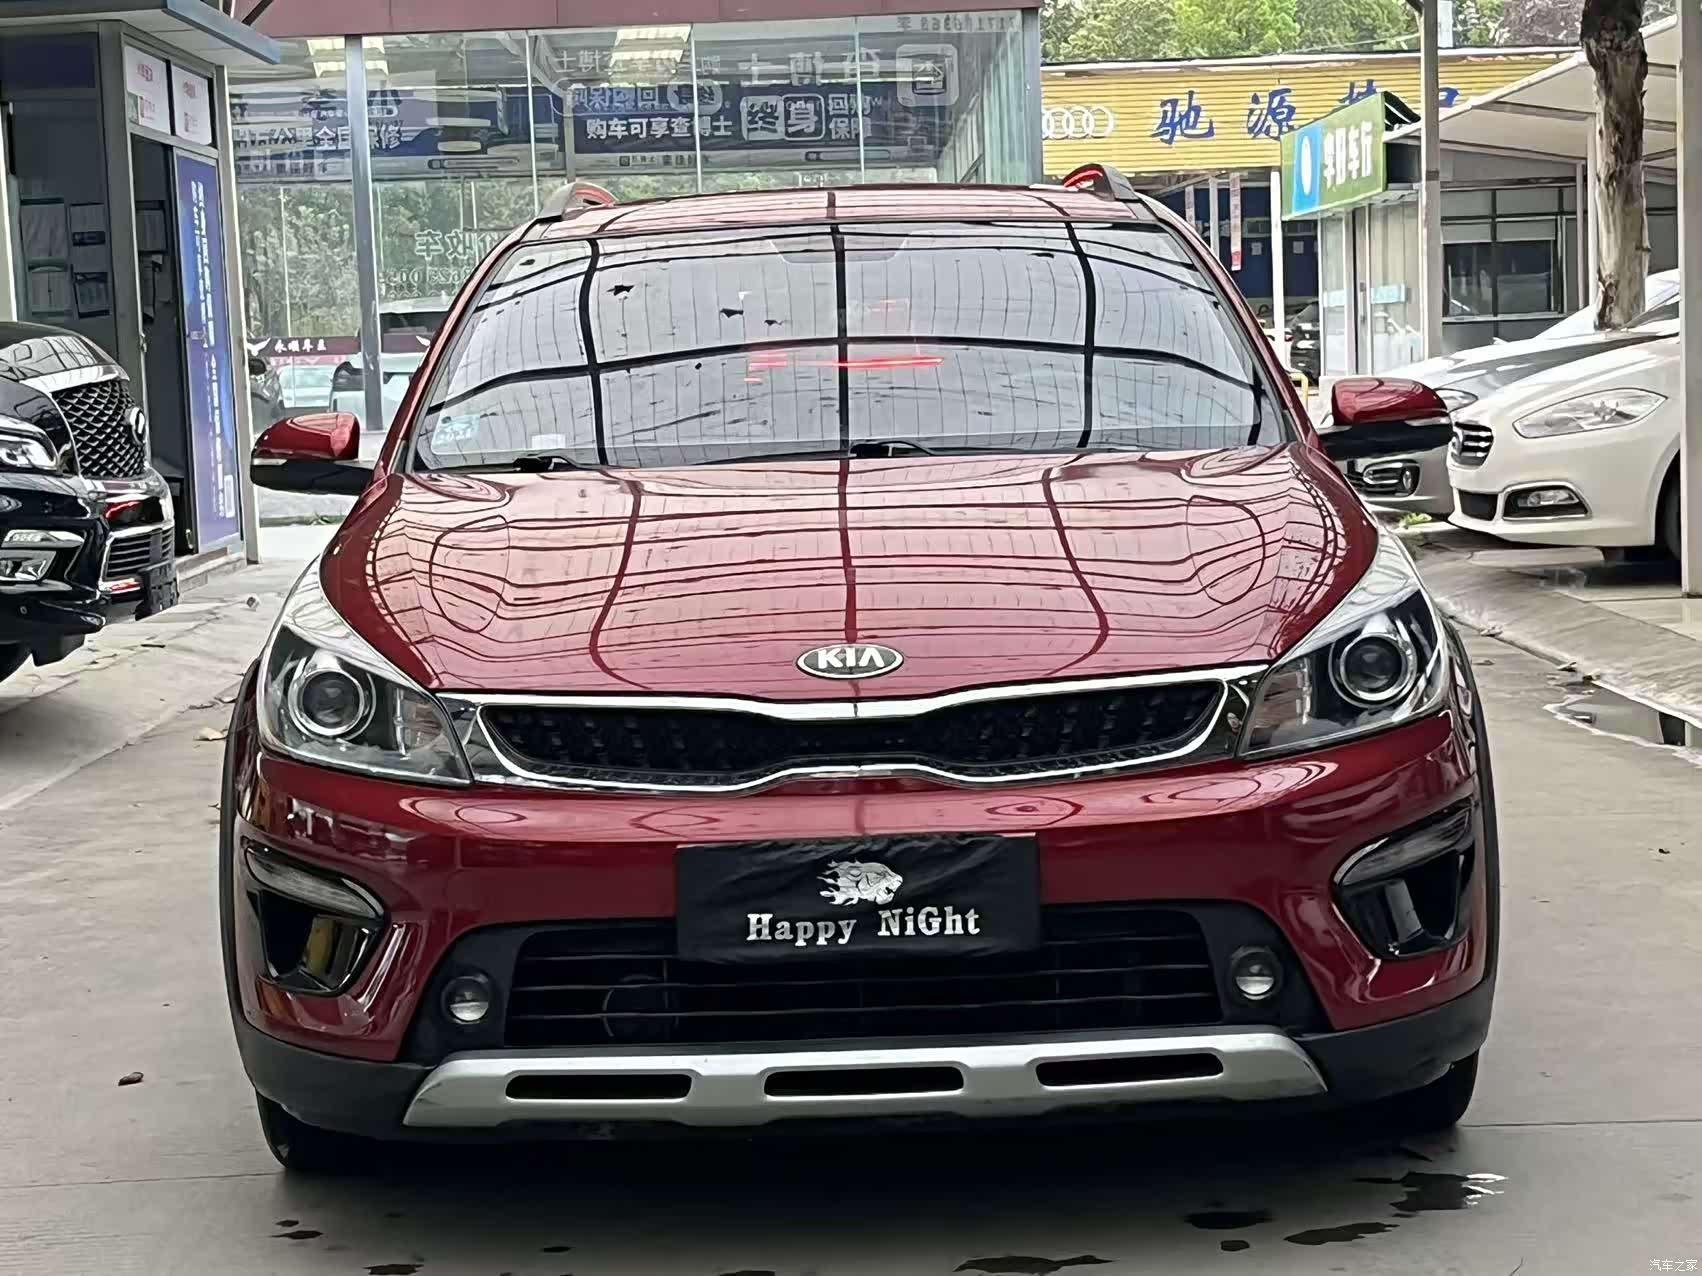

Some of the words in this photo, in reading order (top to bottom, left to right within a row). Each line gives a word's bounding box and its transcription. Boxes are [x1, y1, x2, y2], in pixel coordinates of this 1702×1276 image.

[817, 647, 886, 670] KIA
[746, 913, 857, 947] Happy
[876, 906, 982, 937] NiGht
